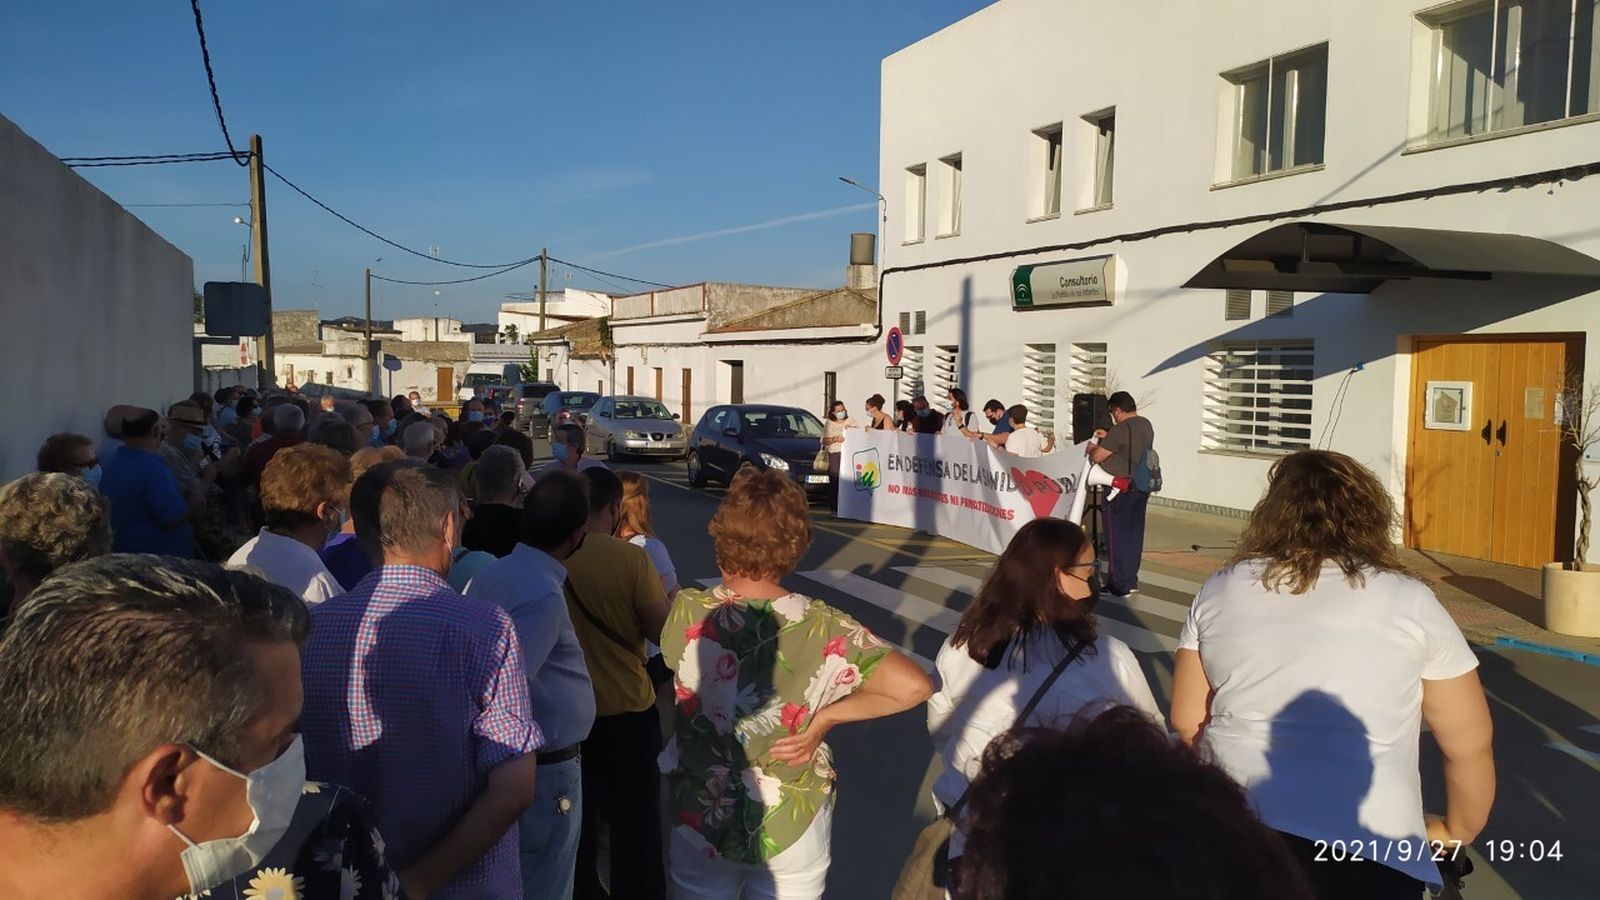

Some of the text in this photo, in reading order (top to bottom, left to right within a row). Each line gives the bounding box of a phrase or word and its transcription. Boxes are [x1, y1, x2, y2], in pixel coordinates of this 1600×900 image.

[1060, 274, 1099, 287] Consultorio
[888, 453, 903, 472] EN
[904, 455, 951, 480] DEFENSA
[953, 462, 968, 482] DE
[970, 464, 981, 485] LA
[888, 484, 900, 494] NO
[950, 495, 959, 506] NI
